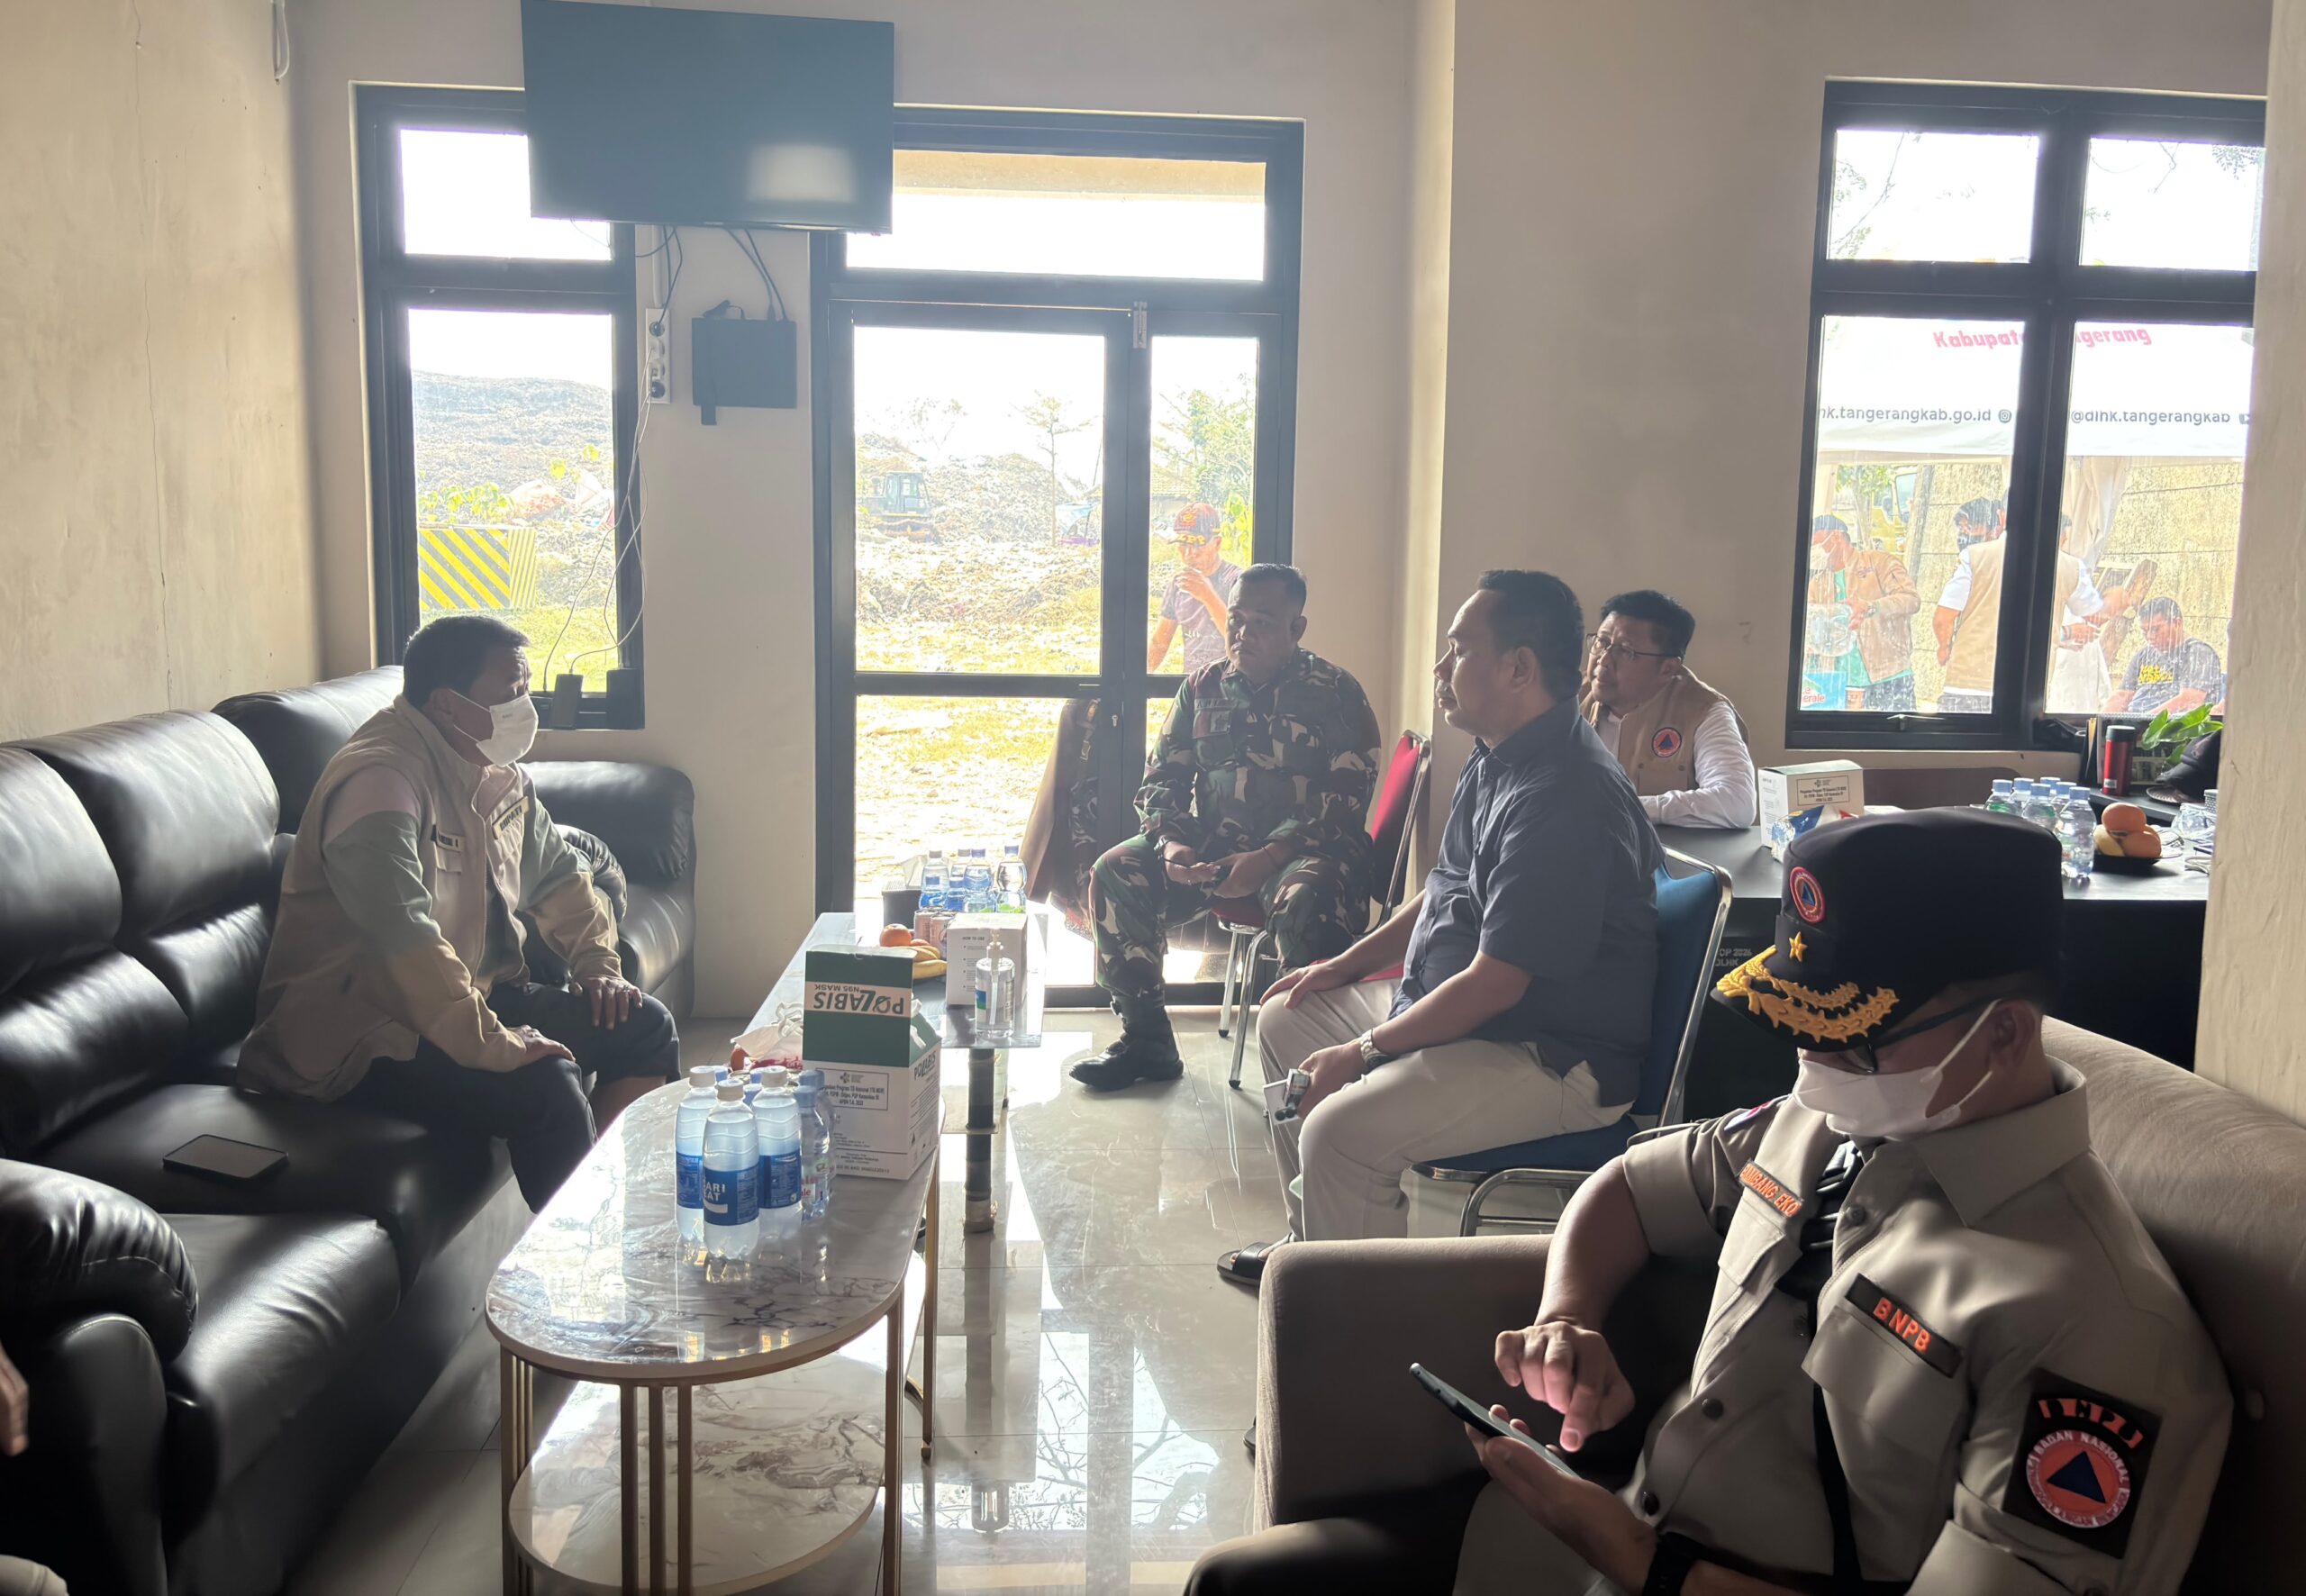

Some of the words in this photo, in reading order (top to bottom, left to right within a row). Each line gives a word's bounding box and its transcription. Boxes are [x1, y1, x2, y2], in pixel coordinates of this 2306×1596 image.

[1933, 330, 2024, 349] Kabupat
[2076, 329, 2152, 348] gerang
[1802, 694, 1824, 702] erale
[704, 1181, 726, 1193] ARI
[1774, 1192, 1801, 1217] EKO
[1873, 1297, 1931, 1353] BNPB
[2033, 1429, 2074, 1455] BADAN
[2080, 1432, 2129, 1483] NASIONAL
